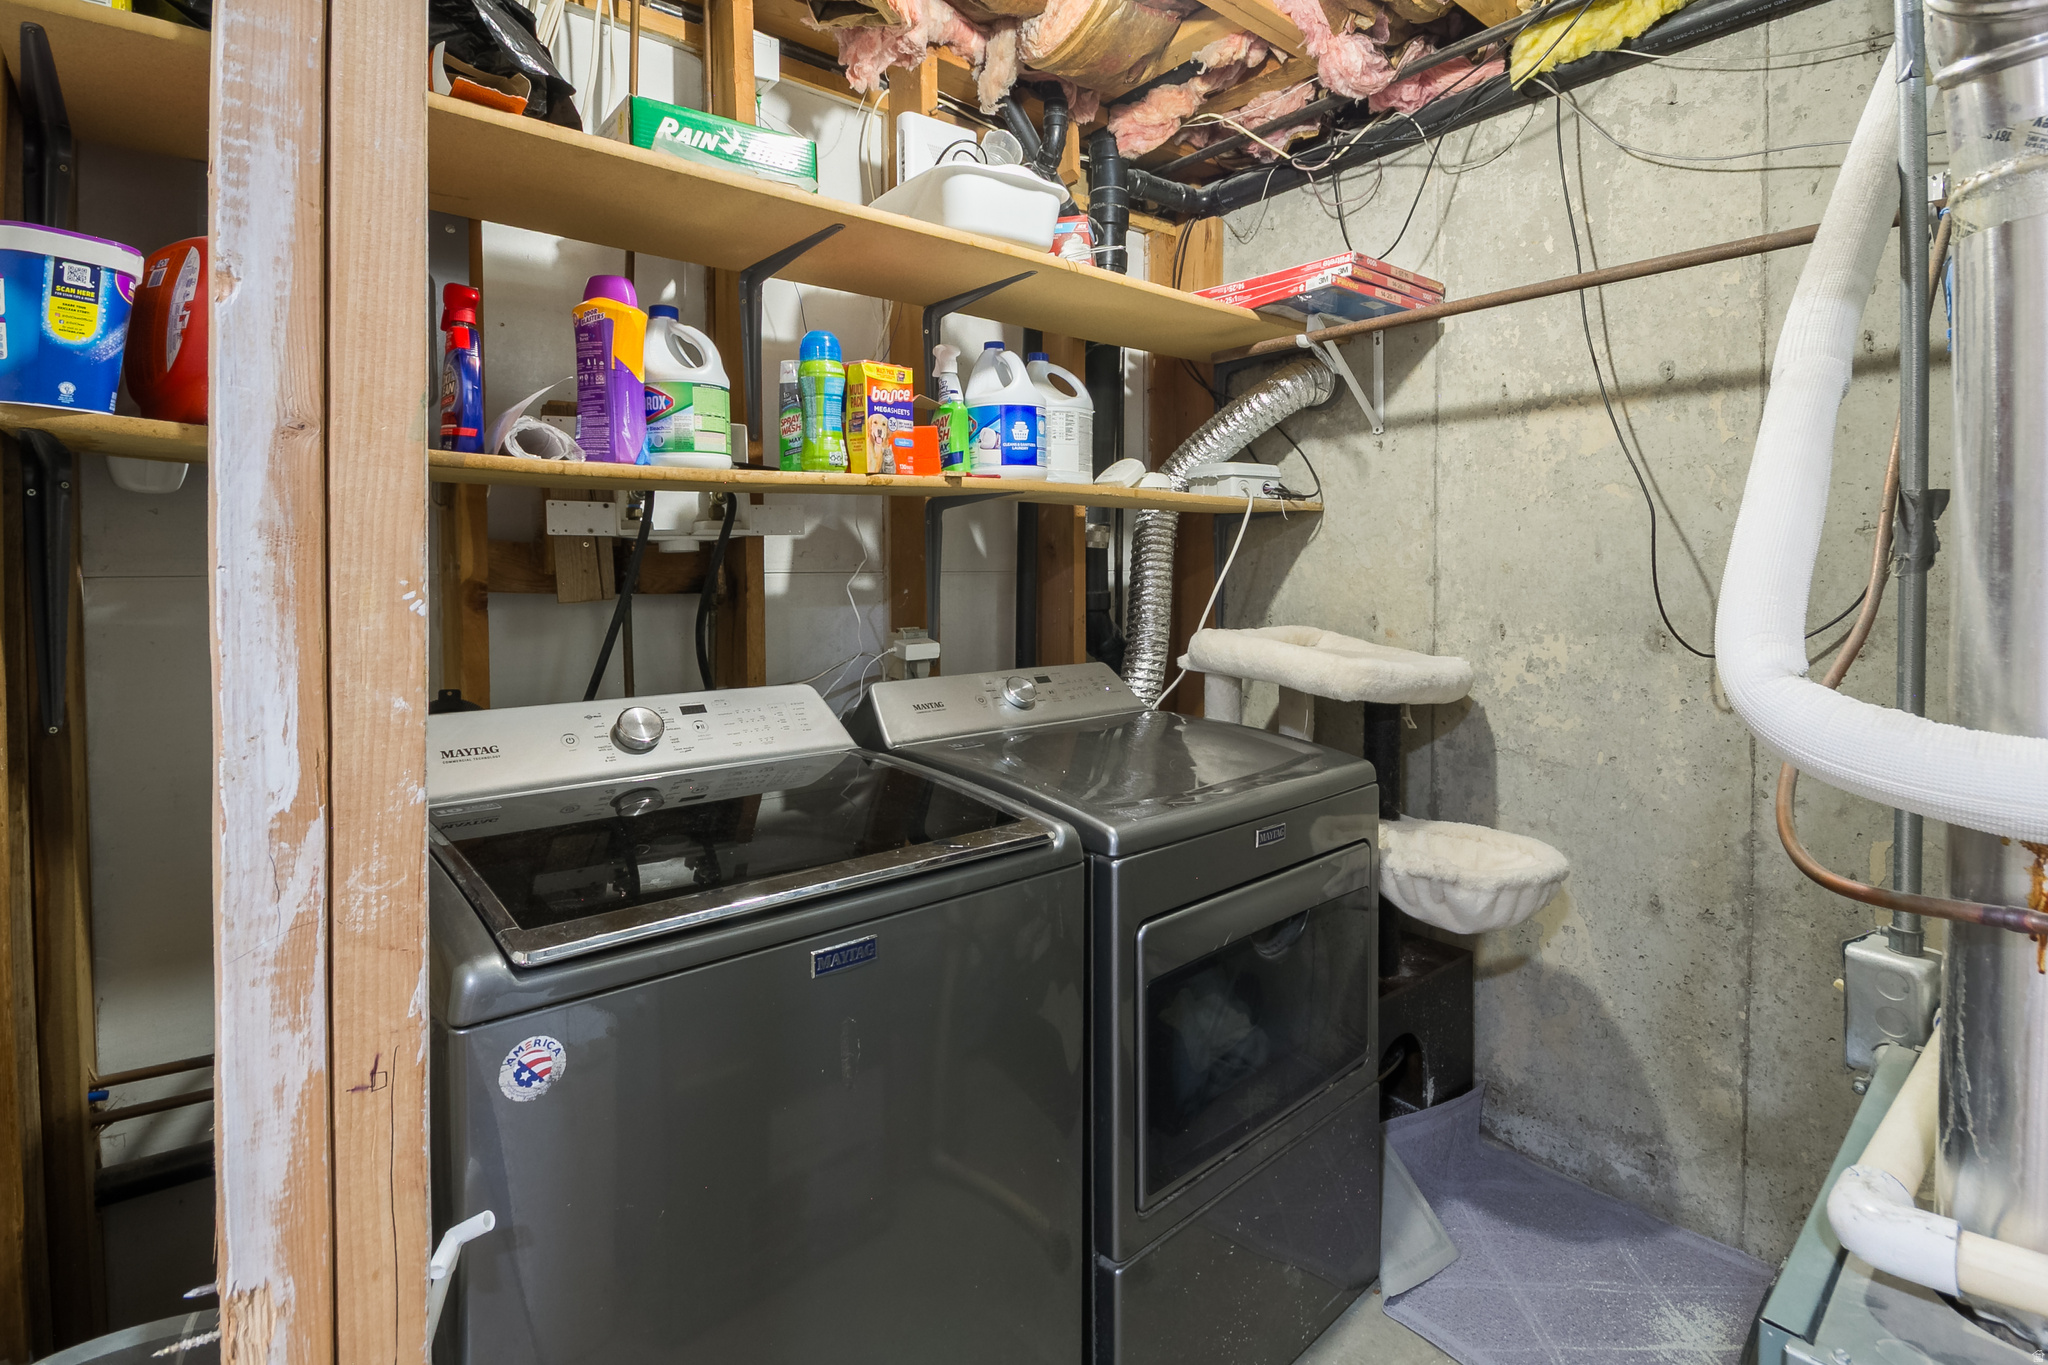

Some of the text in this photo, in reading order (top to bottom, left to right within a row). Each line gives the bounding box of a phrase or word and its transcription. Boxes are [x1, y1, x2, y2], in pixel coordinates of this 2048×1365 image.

[657, 116, 721, 151] RAIN
[1322, 254, 1351, 267] Filtrete
[1338, 266, 1348, 274] 3M
[1318, 275, 1329, 285] 3M
[55, 285, 95, 298] SCAN HERE
[581, 312, 605, 326] BLASTERS
[584, 308, 598, 318] ODOR
[849, 383, 864, 396] MULTI
[871, 386, 911, 404] bounce
[646, 395, 667, 411] ROX
[850, 395, 864, 409] PACK
[873, 405, 911, 416] MEGASHEETS
[780, 413, 801, 428] SPRAY
[781, 423, 802, 437] WASH
[912, 701, 945, 711] MAYTAG
[440, 745, 500, 759] MAYTAG
[1259, 827, 1285, 843] MAYTAG
[816, 942, 875, 971] MAYTAG
[506, 1039, 562, 1067] AMERICA
